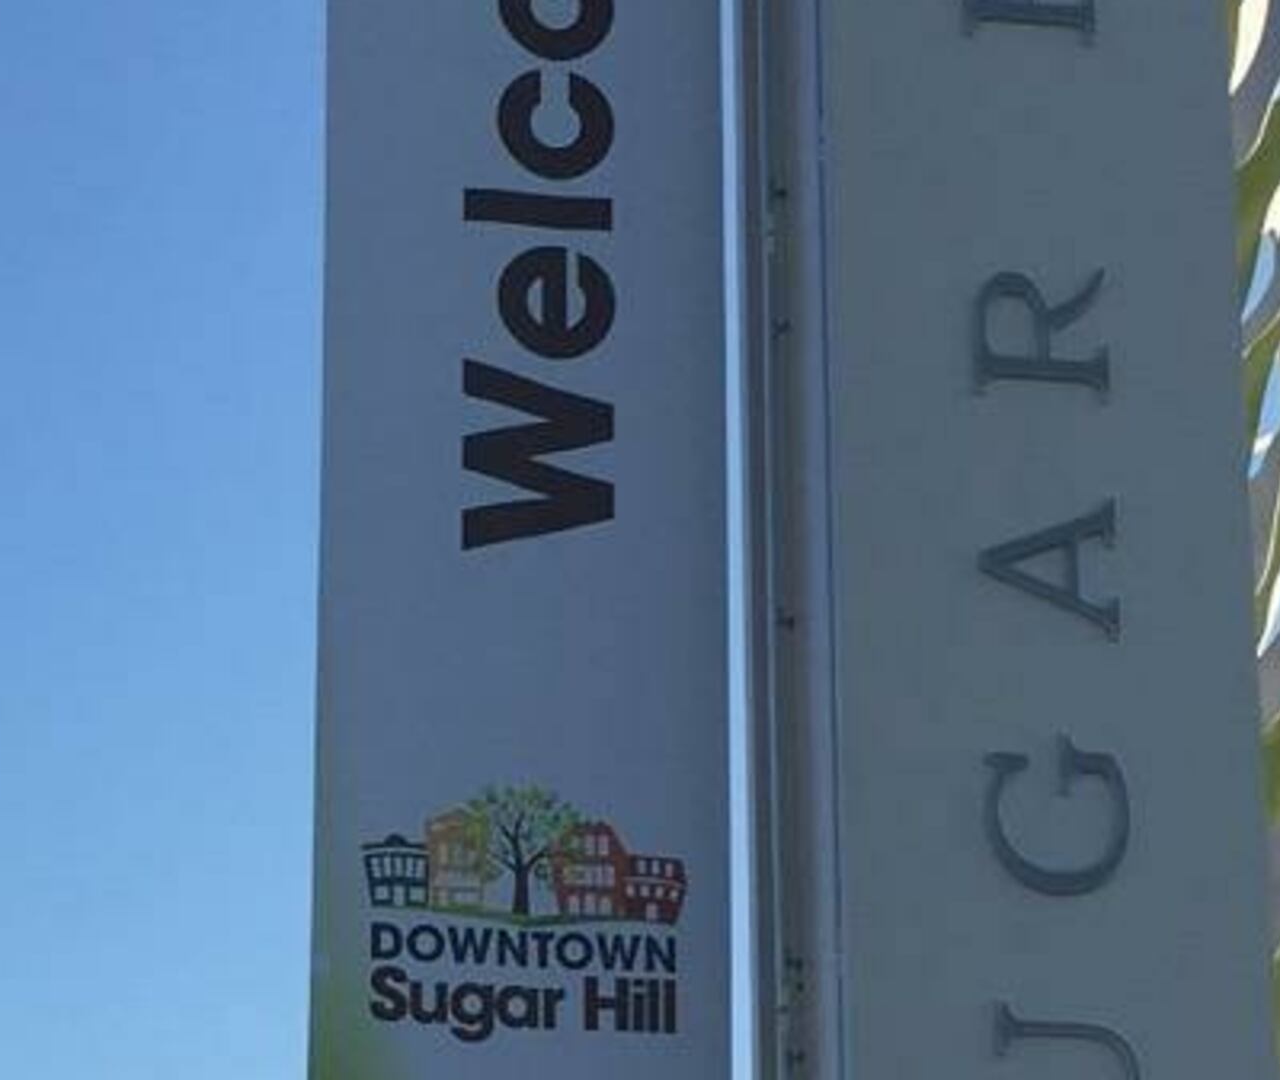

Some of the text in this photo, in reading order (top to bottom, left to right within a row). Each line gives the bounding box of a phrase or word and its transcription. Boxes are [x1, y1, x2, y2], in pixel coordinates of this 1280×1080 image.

[369, 923, 676, 973] DOWNTOWN
[369, 966, 677, 1042] Sugar Hill
